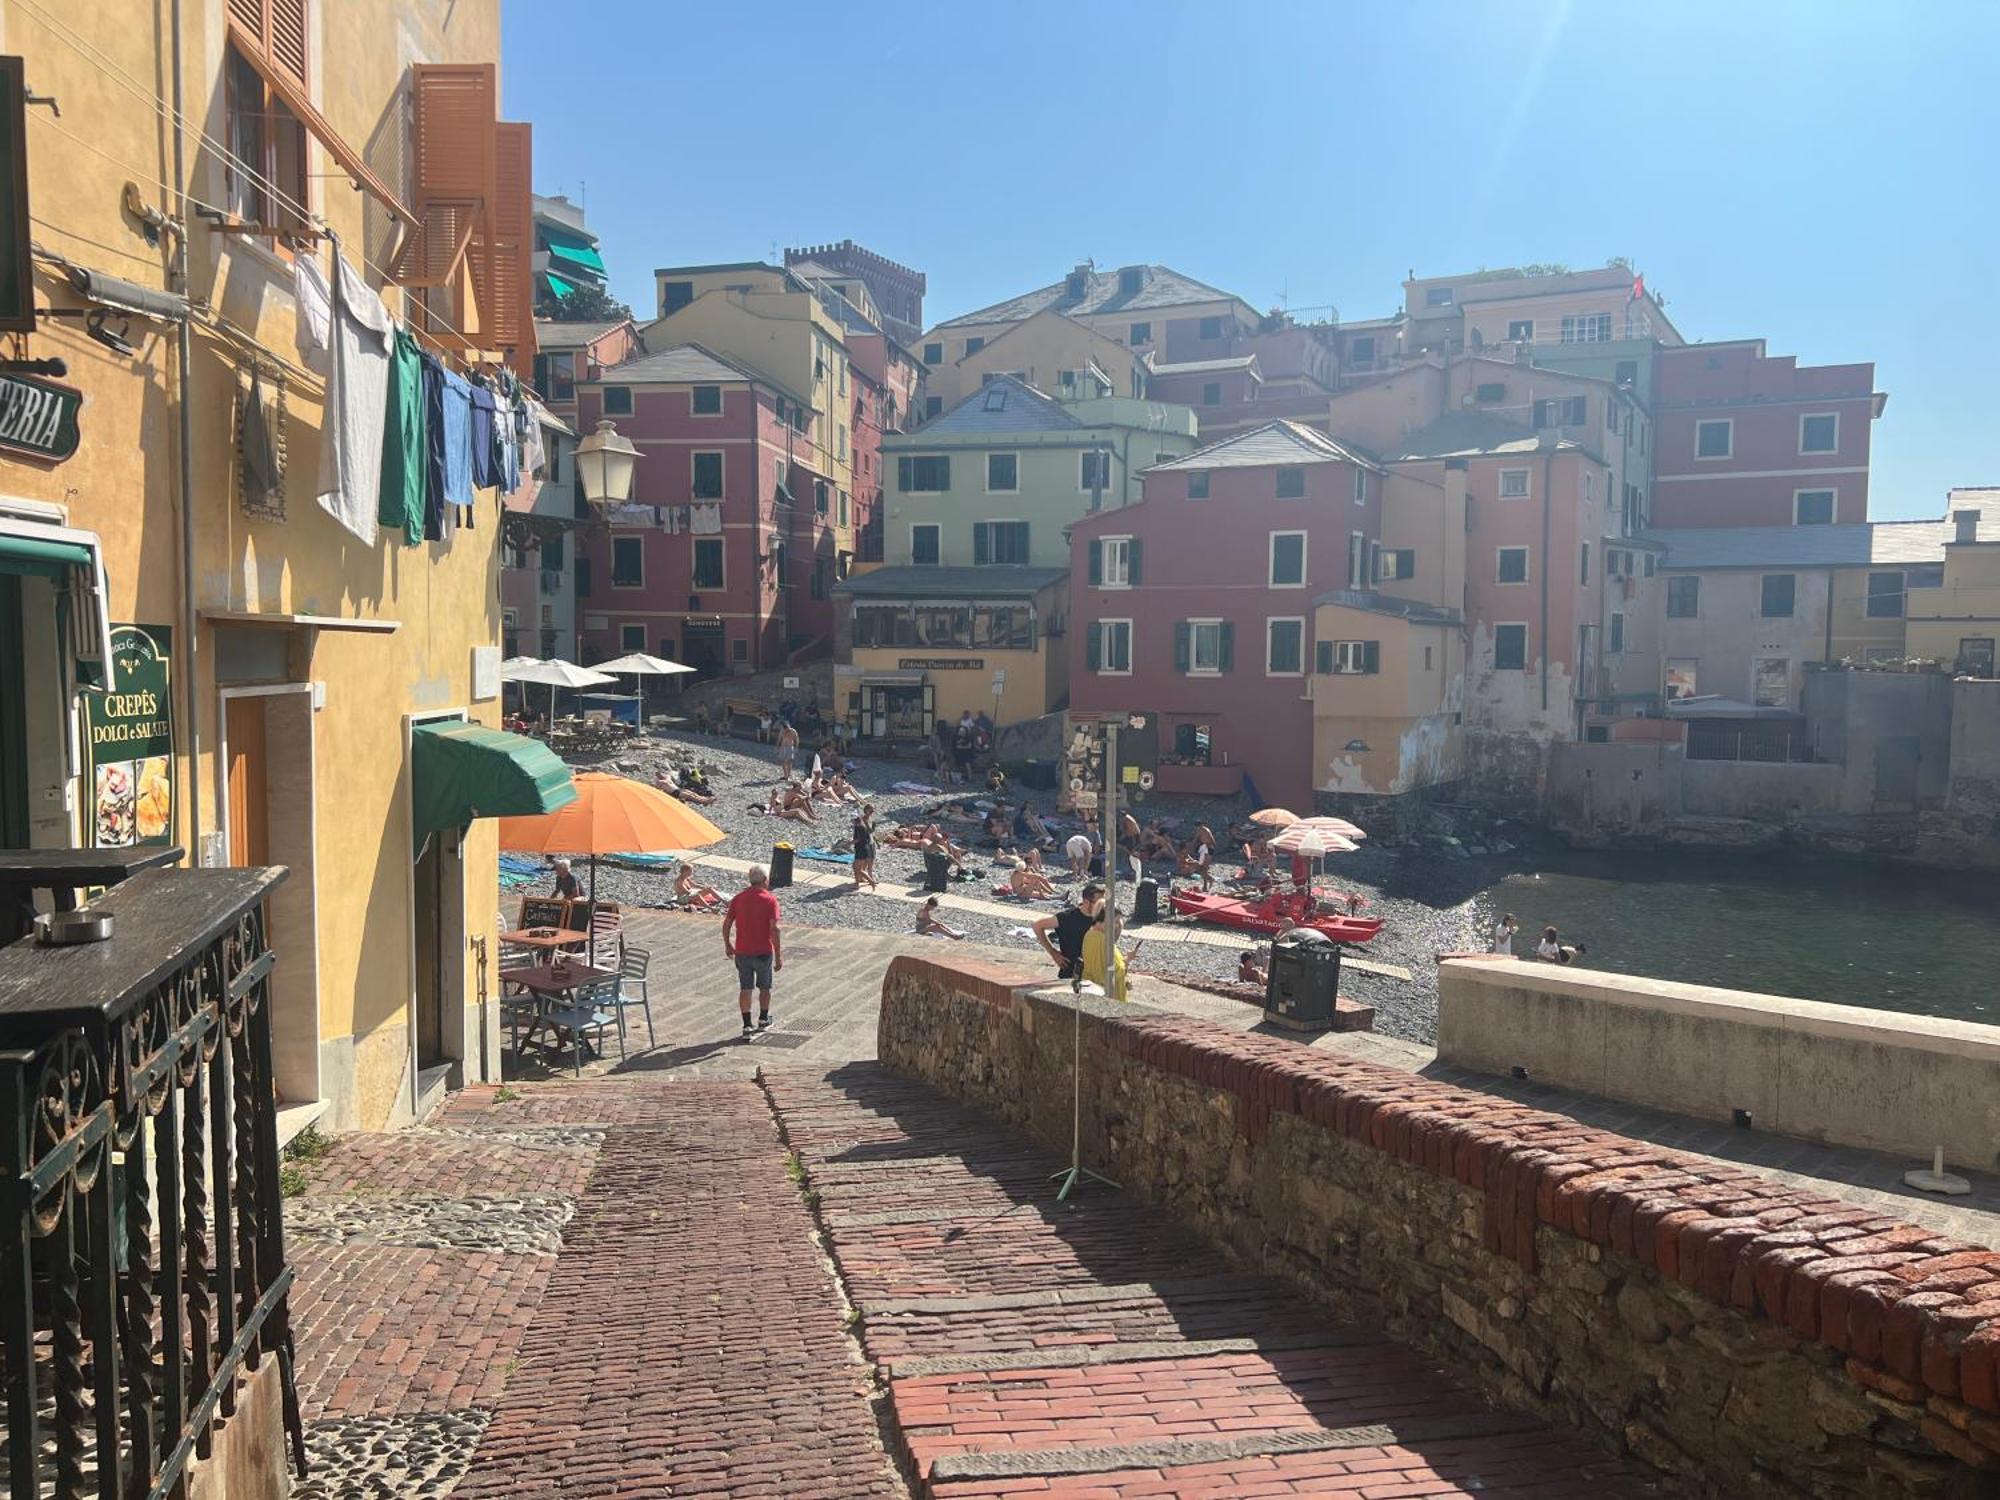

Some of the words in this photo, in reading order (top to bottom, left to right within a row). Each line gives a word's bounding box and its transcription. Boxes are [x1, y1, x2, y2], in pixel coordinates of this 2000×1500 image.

[105, 689, 156, 717] CREPÊS
[94, 725, 128, 743] DOLCI
[130, 729, 136, 739] e
[136, 721, 169, 739] SALATE
